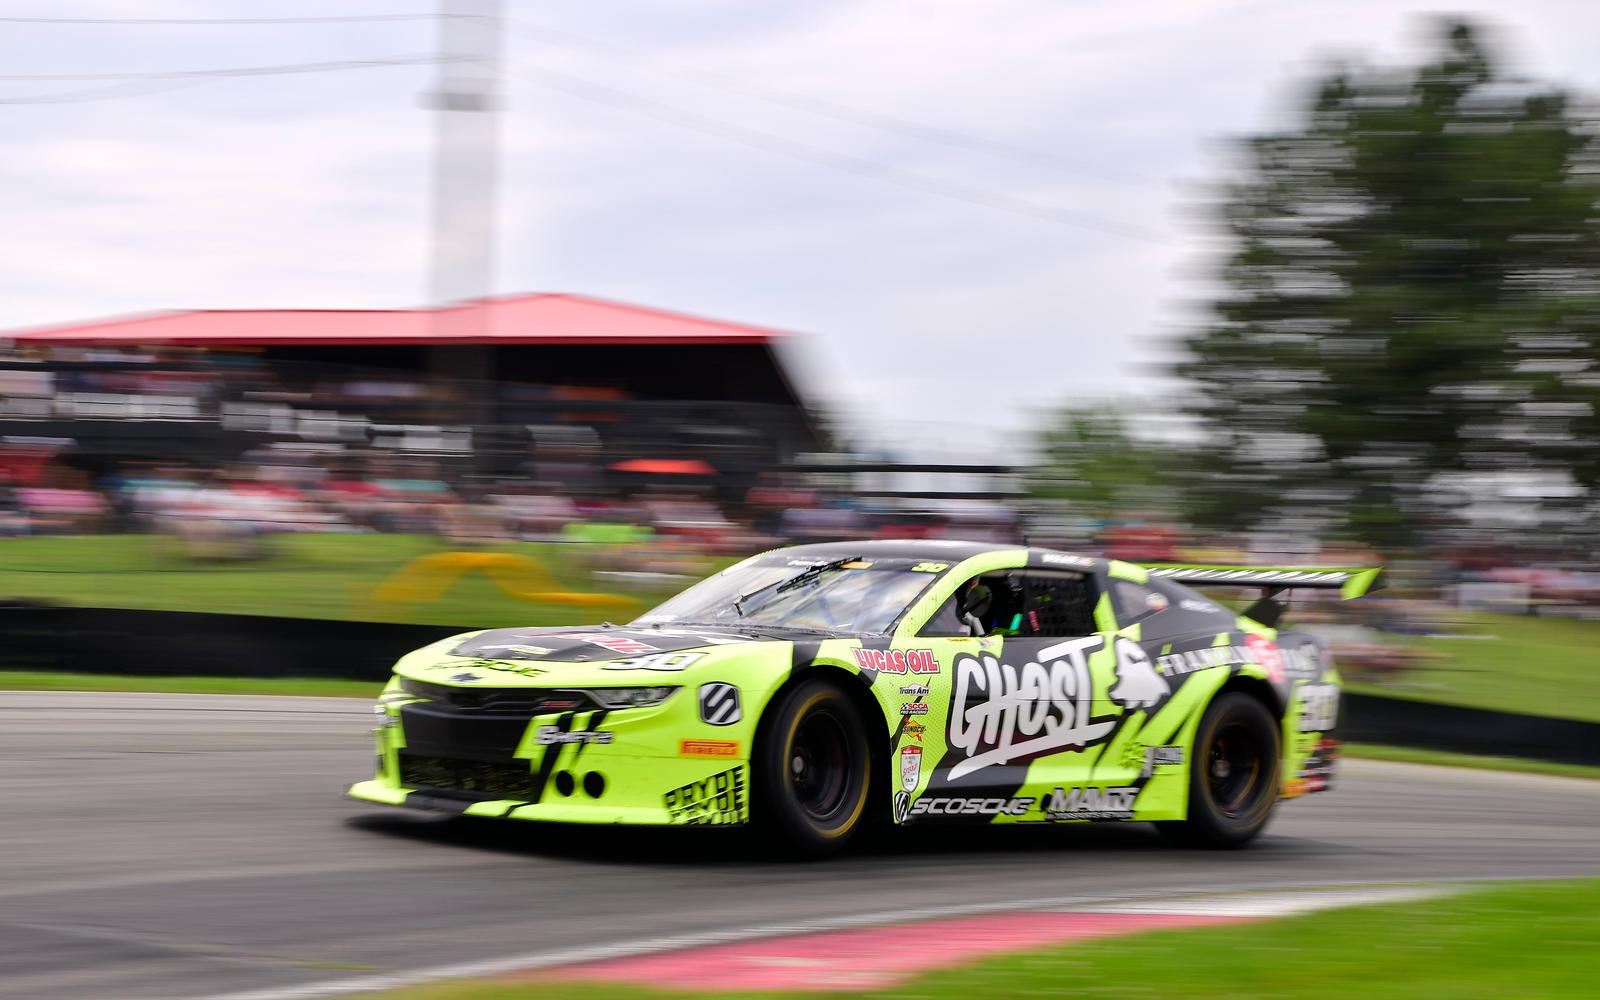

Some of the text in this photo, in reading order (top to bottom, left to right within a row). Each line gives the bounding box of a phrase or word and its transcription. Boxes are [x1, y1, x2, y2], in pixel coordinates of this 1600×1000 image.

[911, 563, 949, 573] 30
[602, 652, 708, 671] 30
[852, 648, 940, 675] LUCAS OIL
[947, 635, 1117, 782] GHOST
[910, 797, 1034, 815] SCOSCHE
